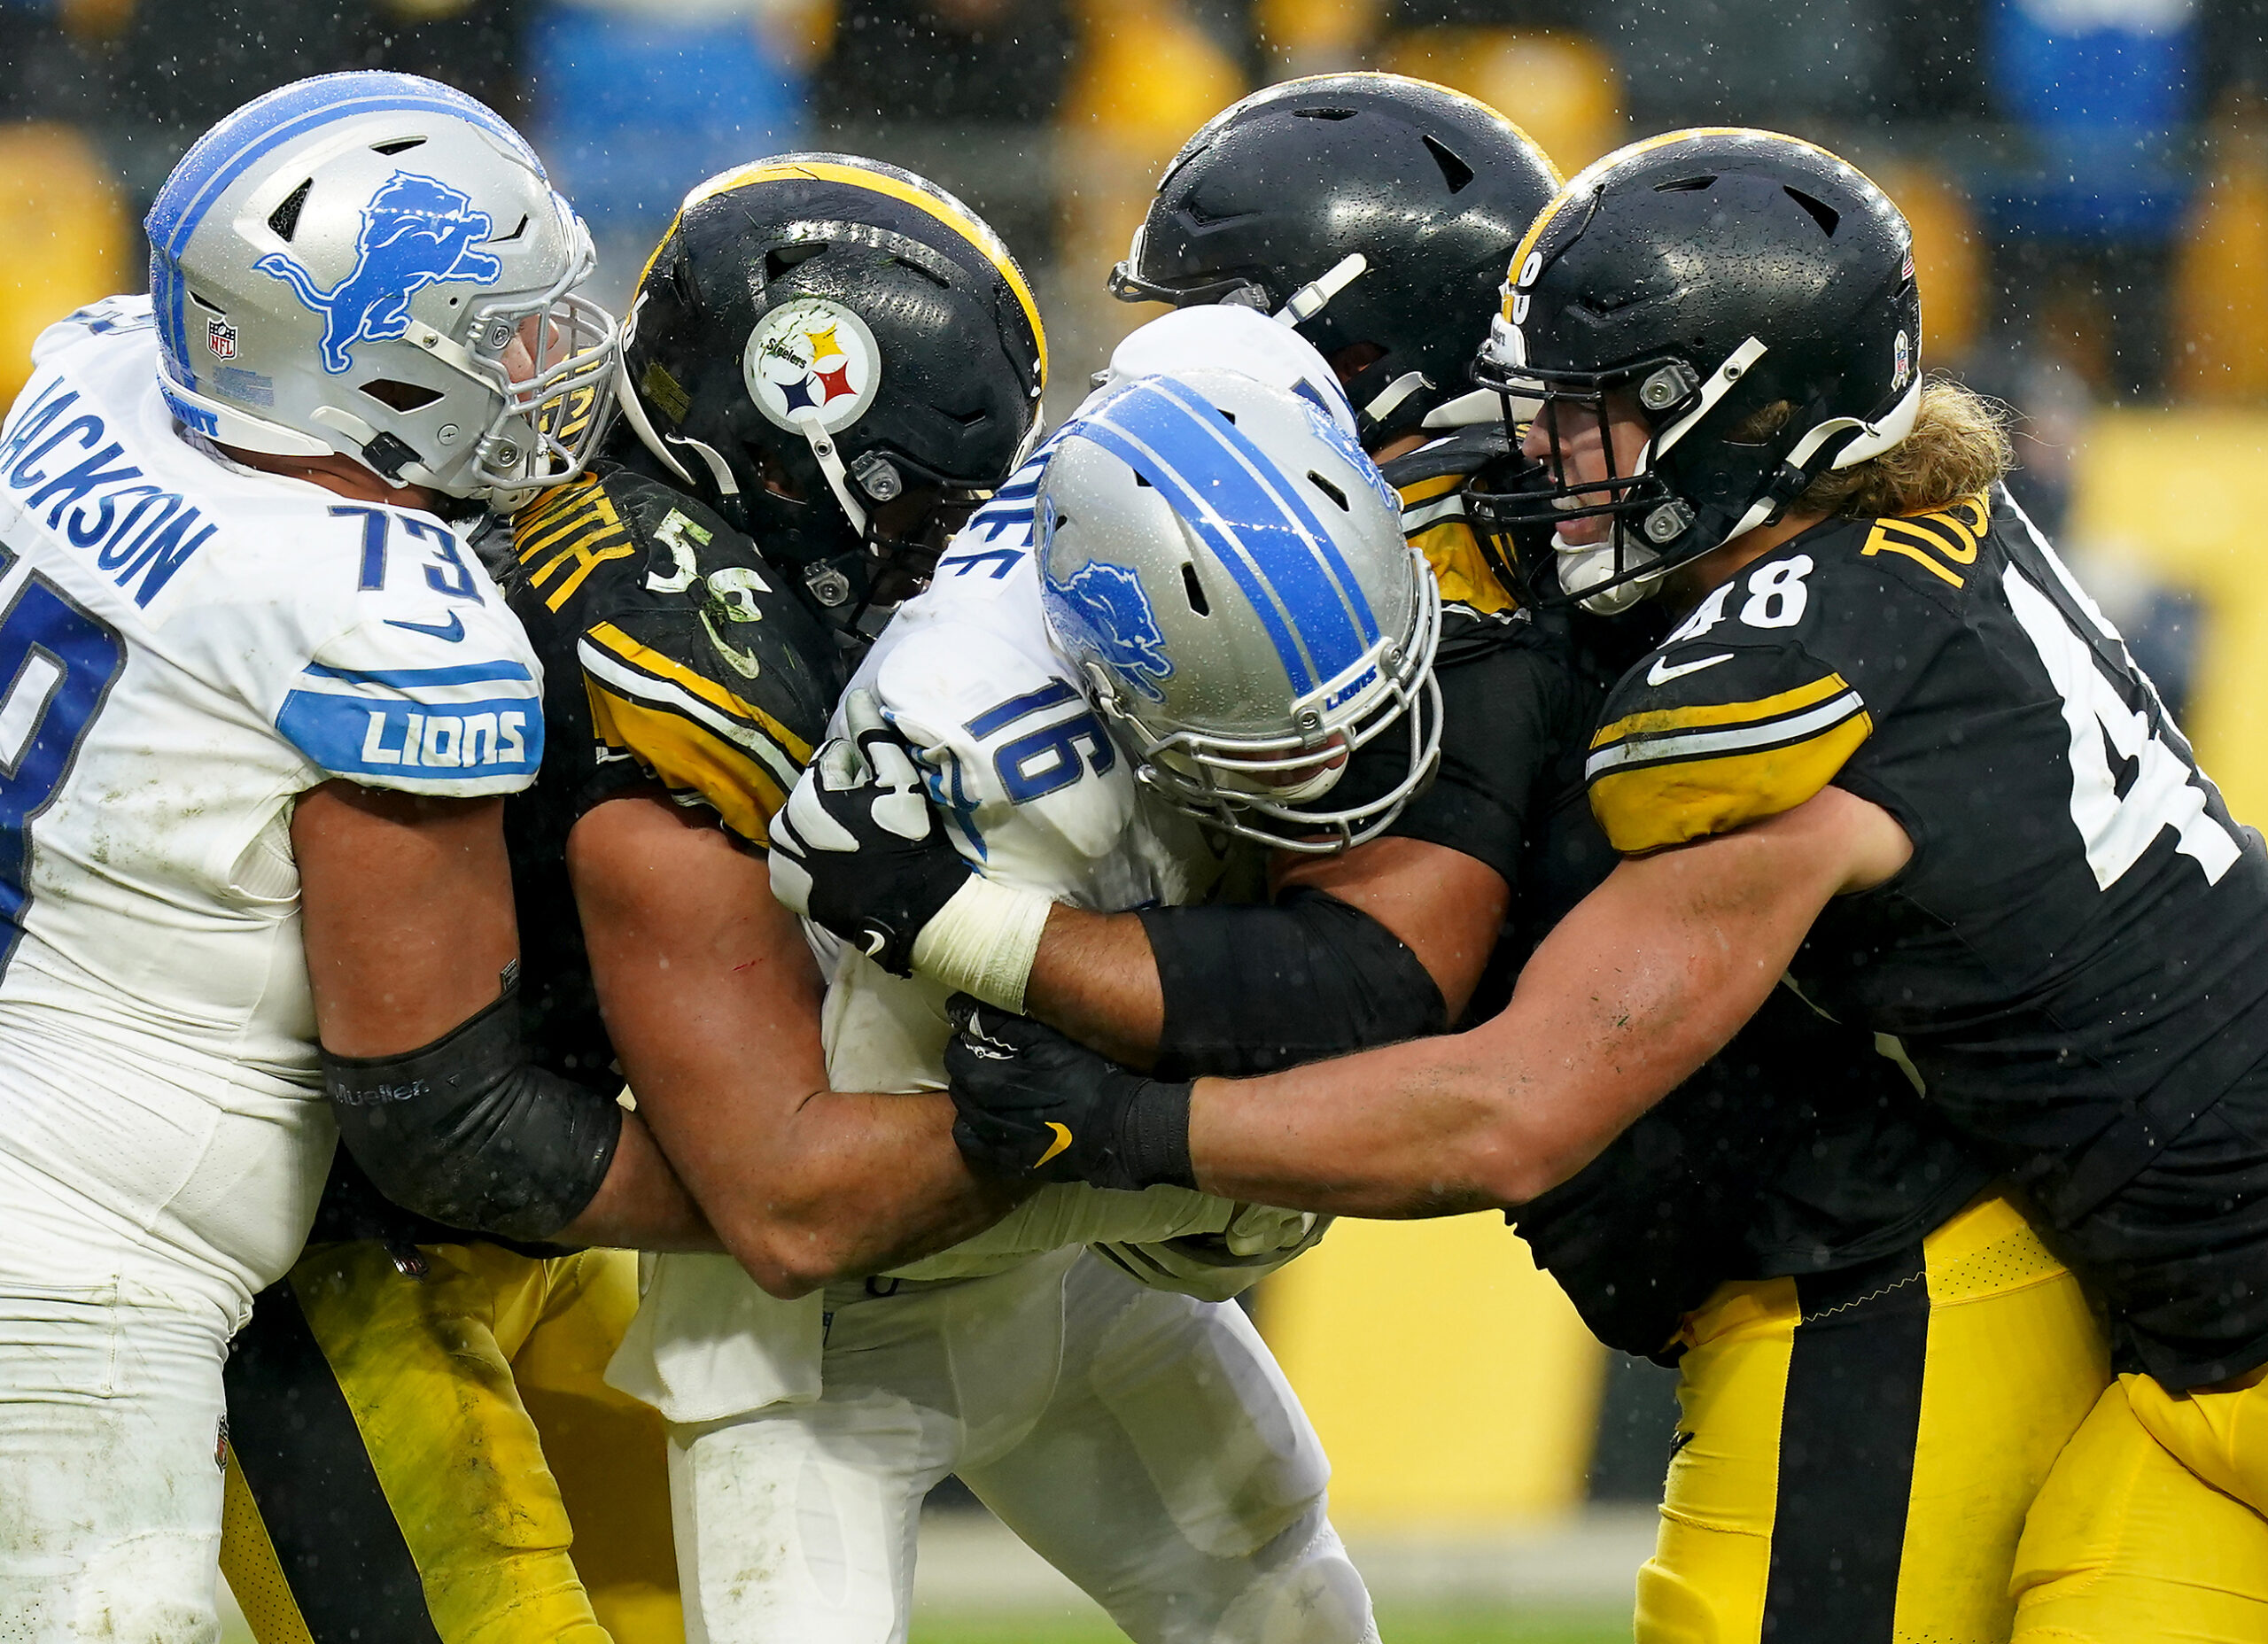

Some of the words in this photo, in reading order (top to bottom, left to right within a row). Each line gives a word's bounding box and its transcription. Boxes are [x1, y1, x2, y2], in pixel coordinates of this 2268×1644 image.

[210, 334, 233, 355] NFL
[765, 337, 807, 369] Steelers
[327, 504, 486, 608] 73
[644, 507, 773, 624] 56
[1656, 554, 1814, 651] 48
[1325, 663, 1377, 711] LIONS
[361, 710, 527, 768] LIONS
[961, 675, 1116, 806] 16
